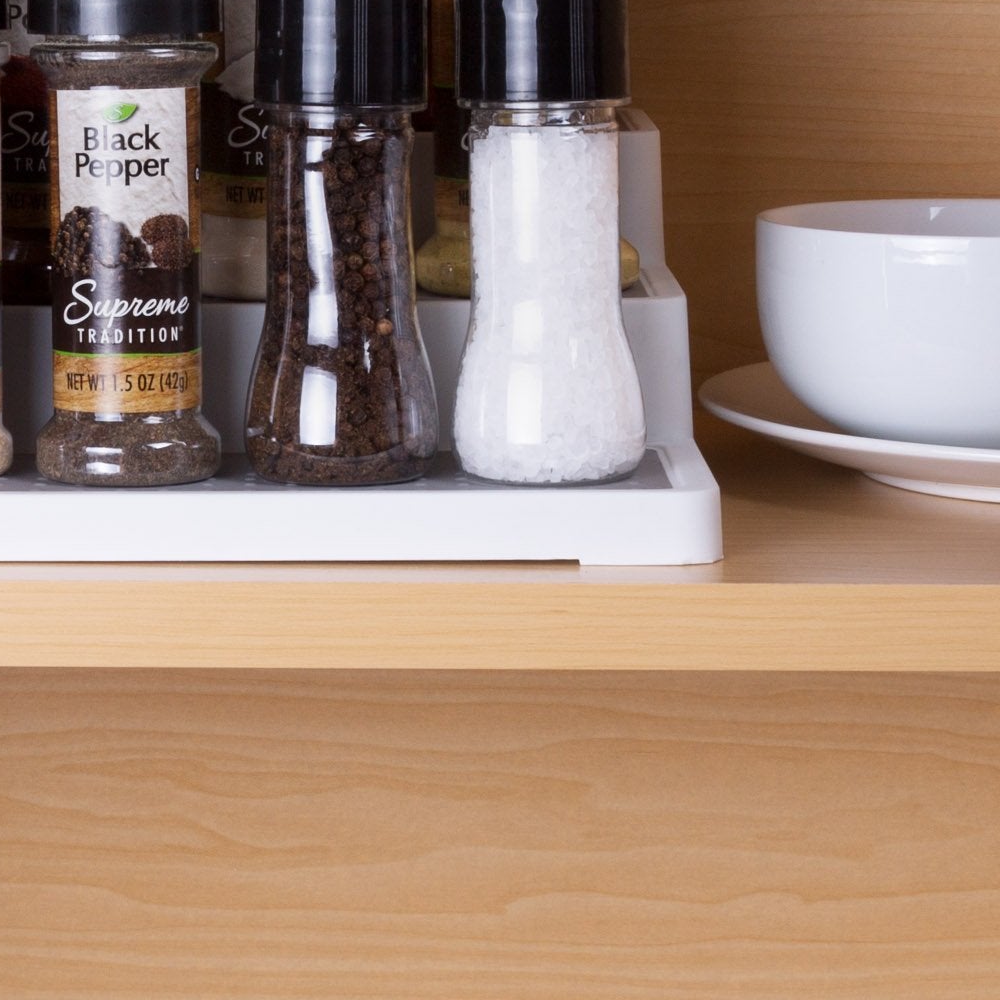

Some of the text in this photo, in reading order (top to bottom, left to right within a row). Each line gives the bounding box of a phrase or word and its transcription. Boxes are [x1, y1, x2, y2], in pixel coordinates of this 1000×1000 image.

[83, 123, 161, 151] Black
[75, 152, 170, 186] Pepper
[226, 185, 264, 203] NET WT
[63, 278, 190, 328] Supreme
[77, 326, 179, 344] TRADITION
[67, 371, 189, 393] NET WT 1.5 OZ (42g)
